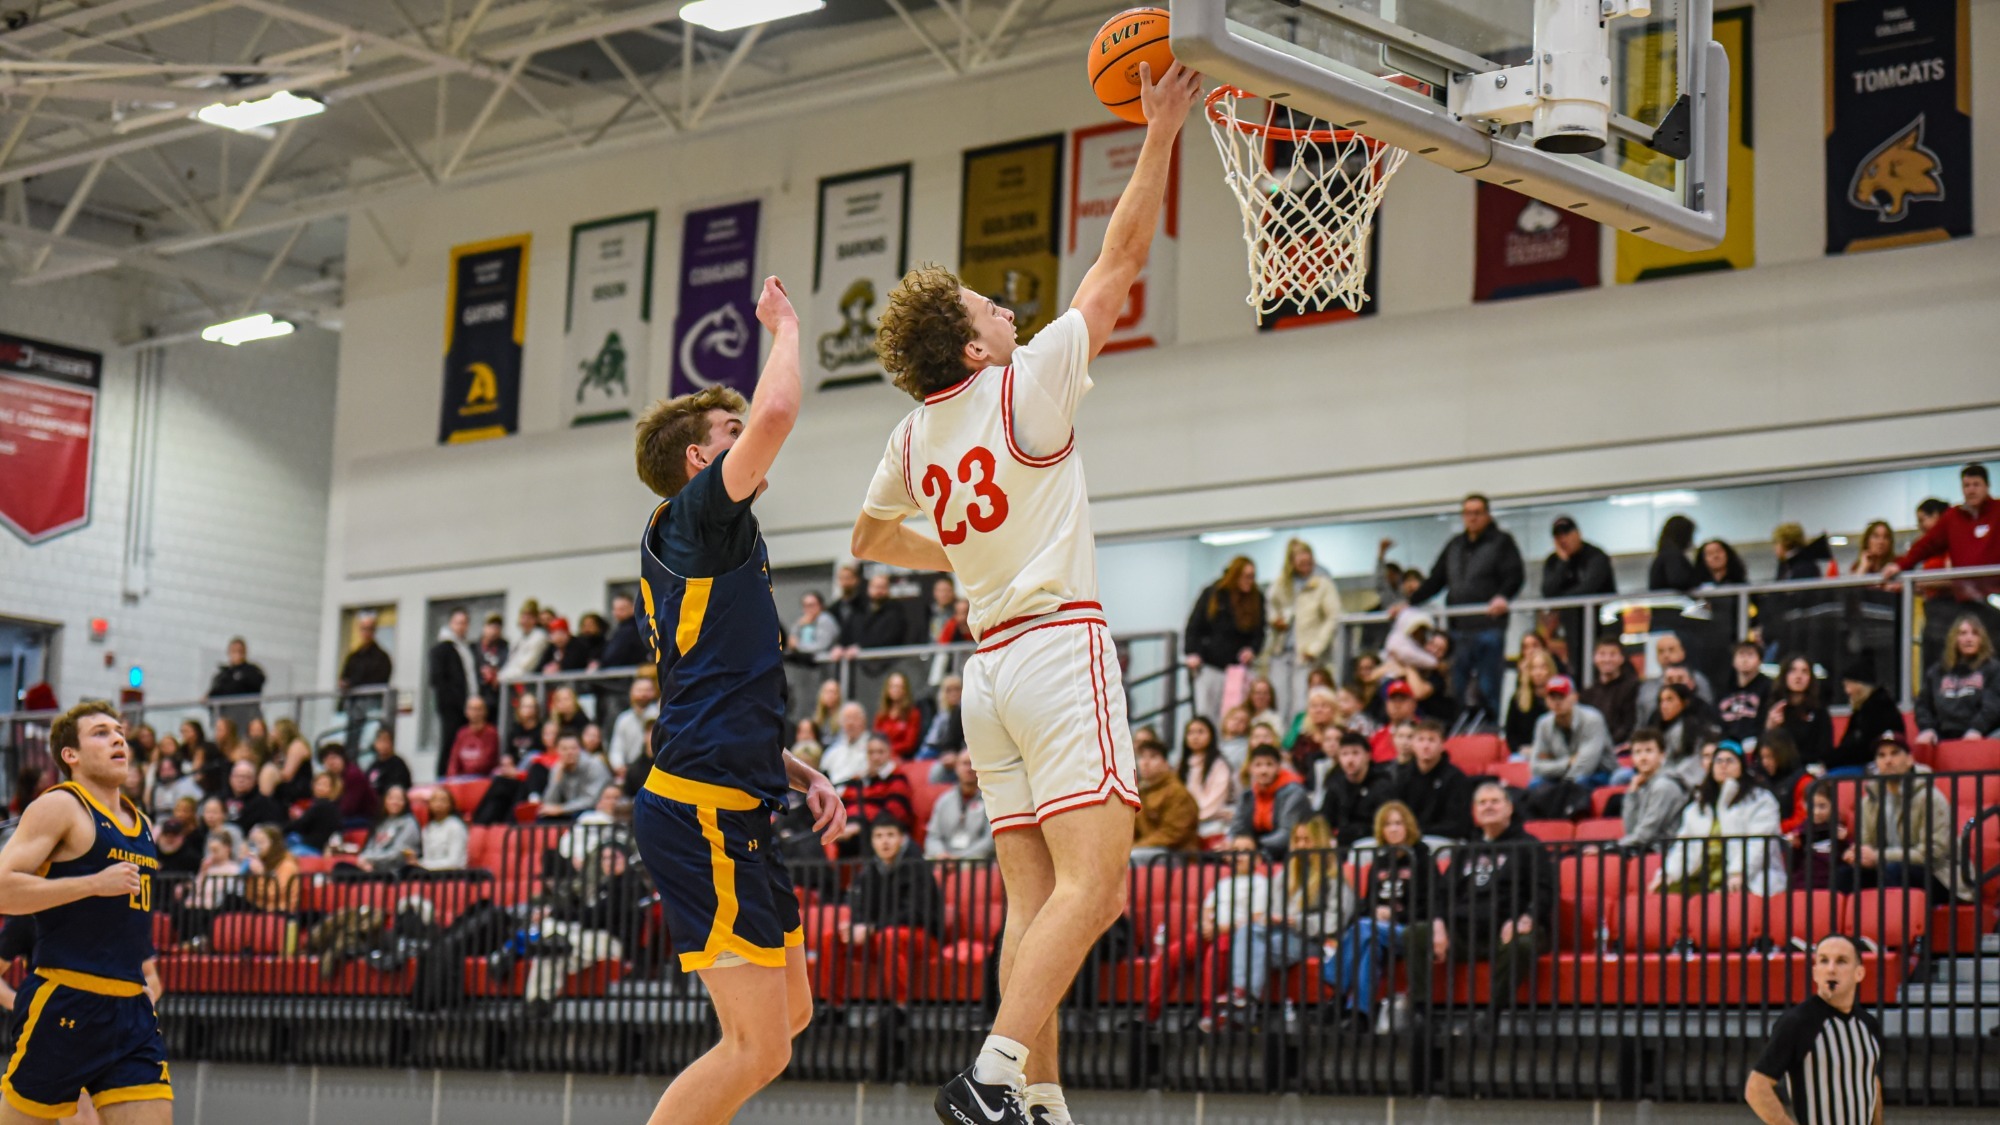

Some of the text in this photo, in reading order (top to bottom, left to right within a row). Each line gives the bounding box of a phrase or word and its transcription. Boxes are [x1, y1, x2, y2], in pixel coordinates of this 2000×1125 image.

[1852, 57, 1946, 94] TOMCATS
[462, 302, 508, 327] GATORS
[921, 446, 1009, 547] 23
